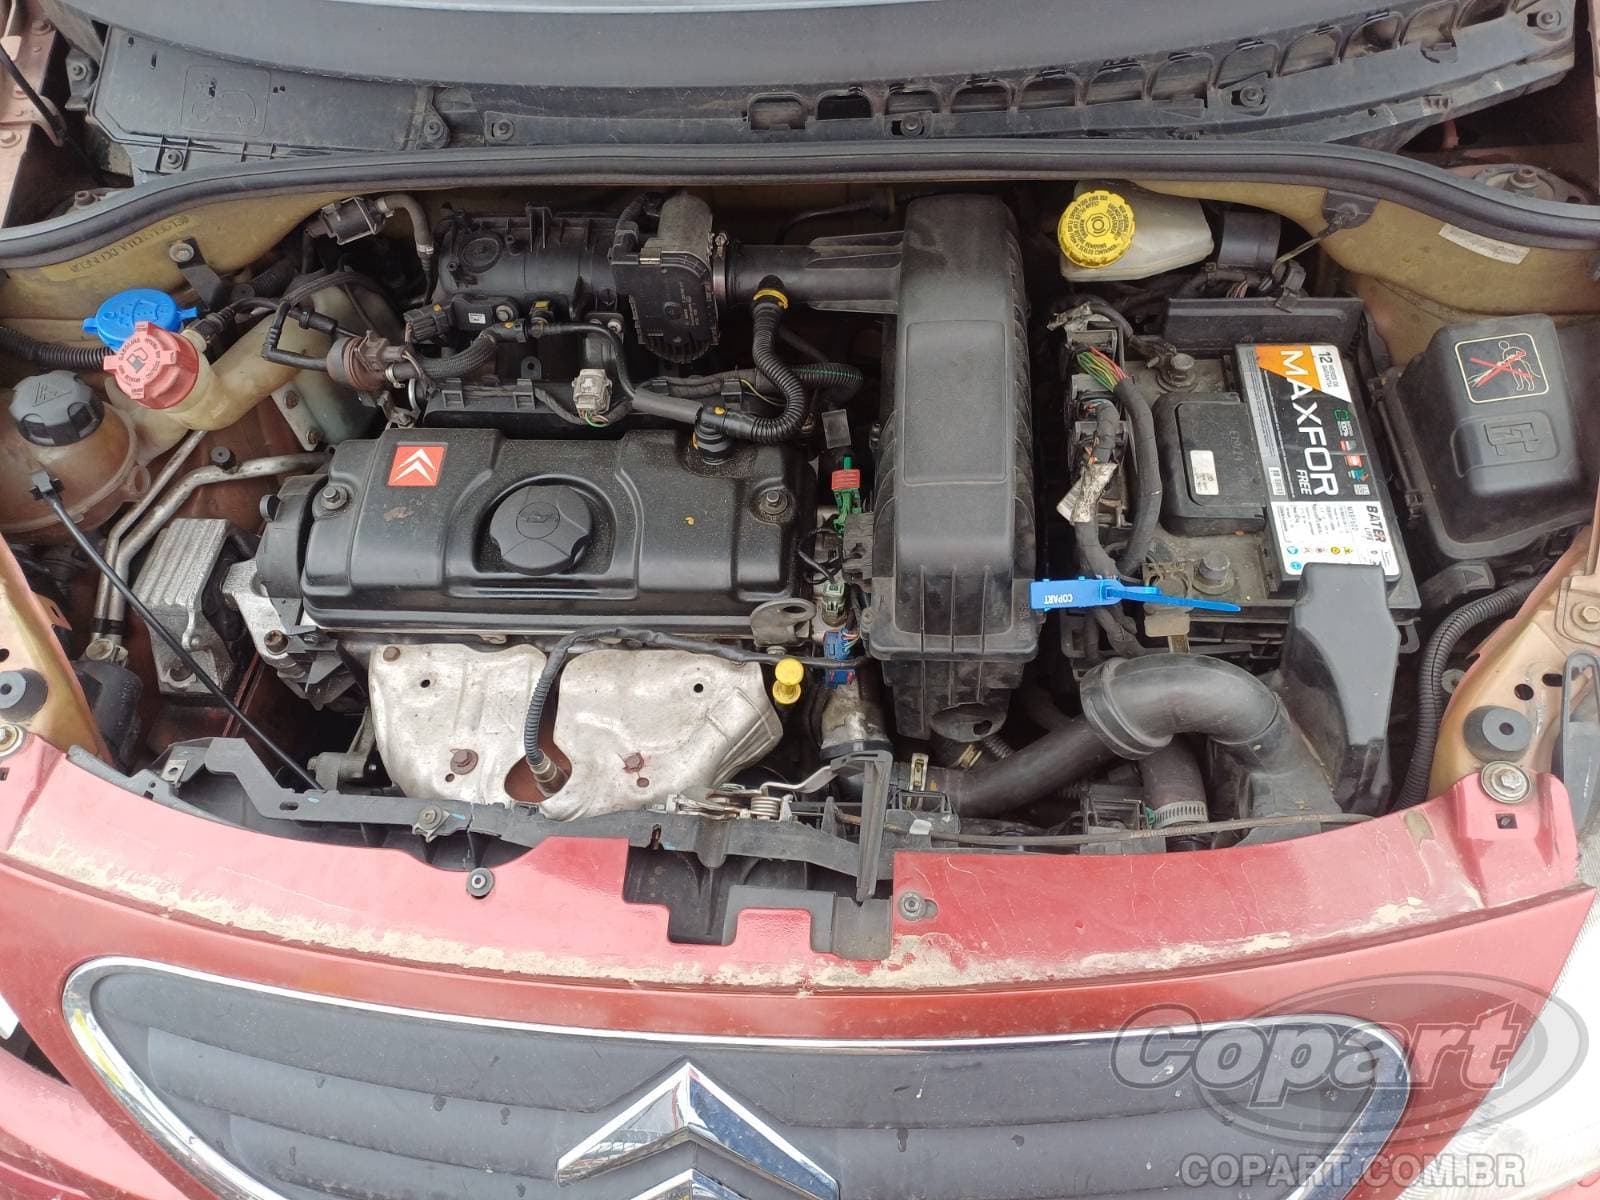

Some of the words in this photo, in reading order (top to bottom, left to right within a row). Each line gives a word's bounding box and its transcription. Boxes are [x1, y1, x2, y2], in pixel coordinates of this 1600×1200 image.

[1318, 351, 1333, 364] 12
[1280, 350, 1339, 496] MAXFOR
[1296, 469, 1313, 495] FREE
[1043, 593, 1073, 605] COPART
